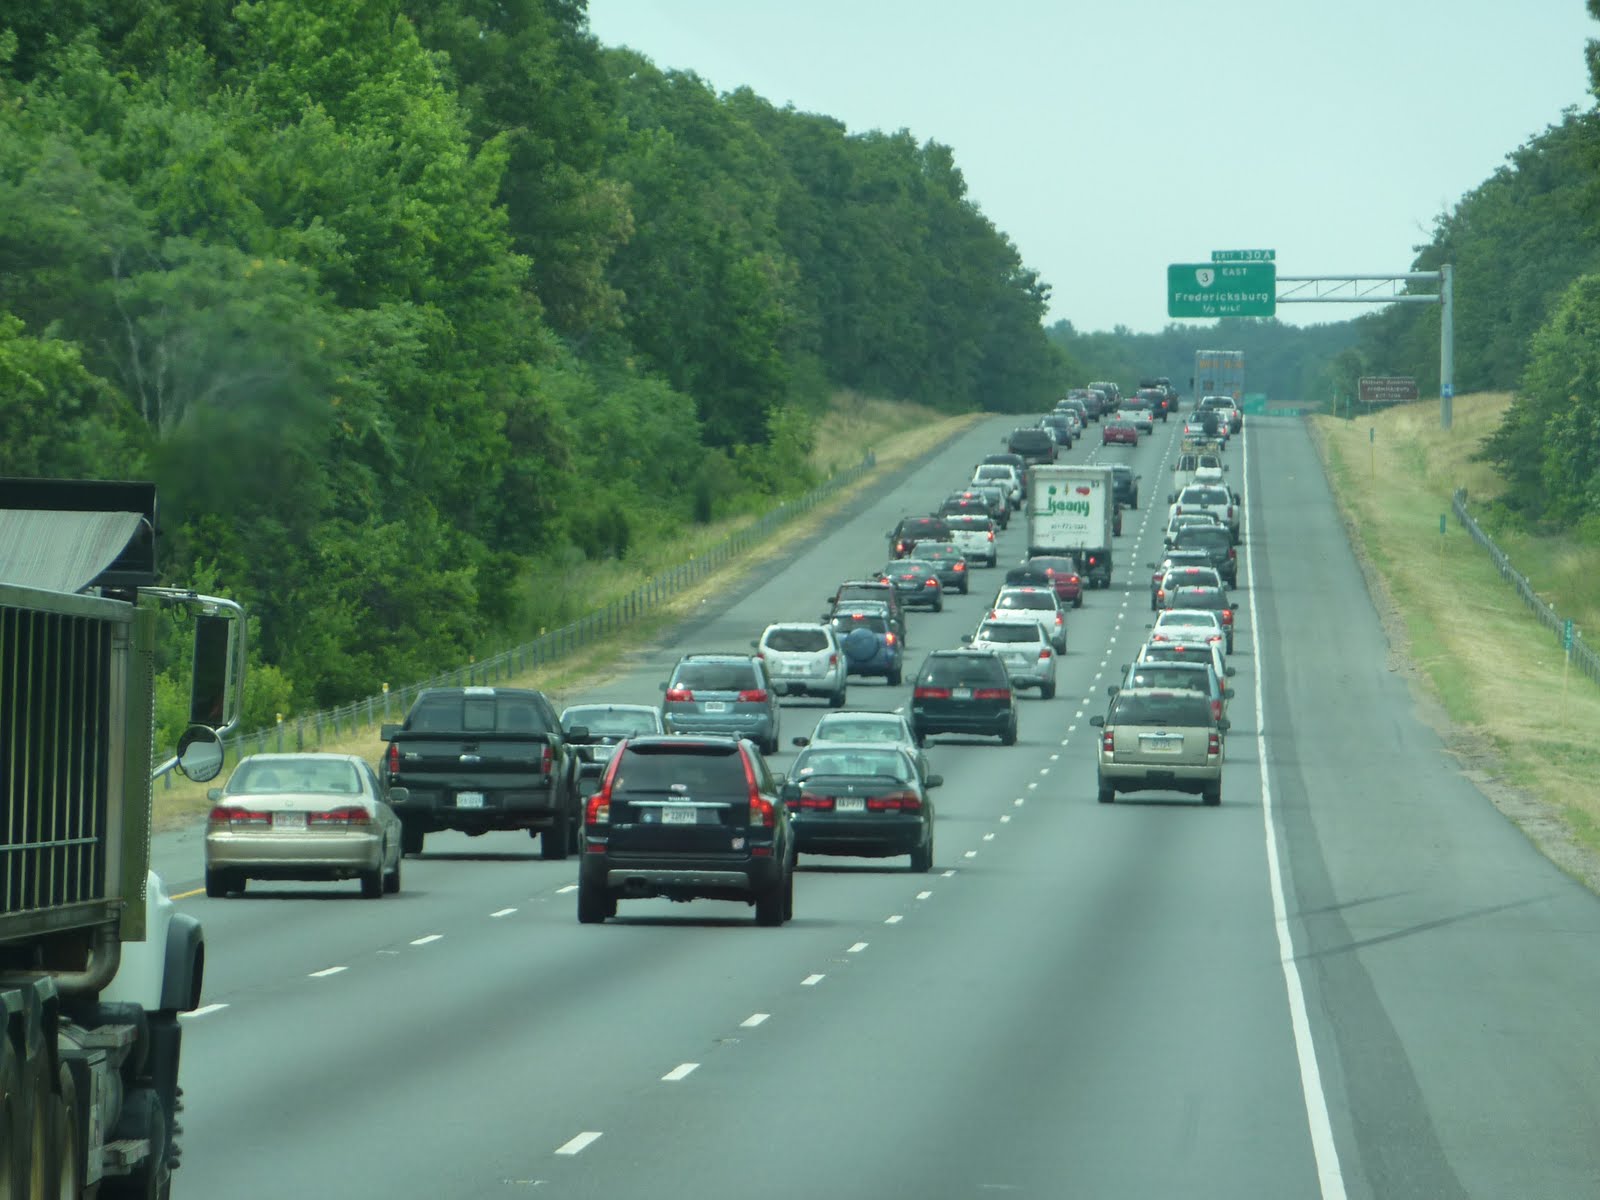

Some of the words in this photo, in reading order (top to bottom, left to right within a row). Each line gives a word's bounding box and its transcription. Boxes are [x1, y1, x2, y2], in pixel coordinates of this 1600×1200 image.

[1215, 252, 1233, 260] EXIT
[1240, 250, 1271, 260] 130A
[1201, 272, 1209, 283] 3
[1222, 268, 1247, 276] EAST
[1175, 292, 1269, 303] Fredericksburg
